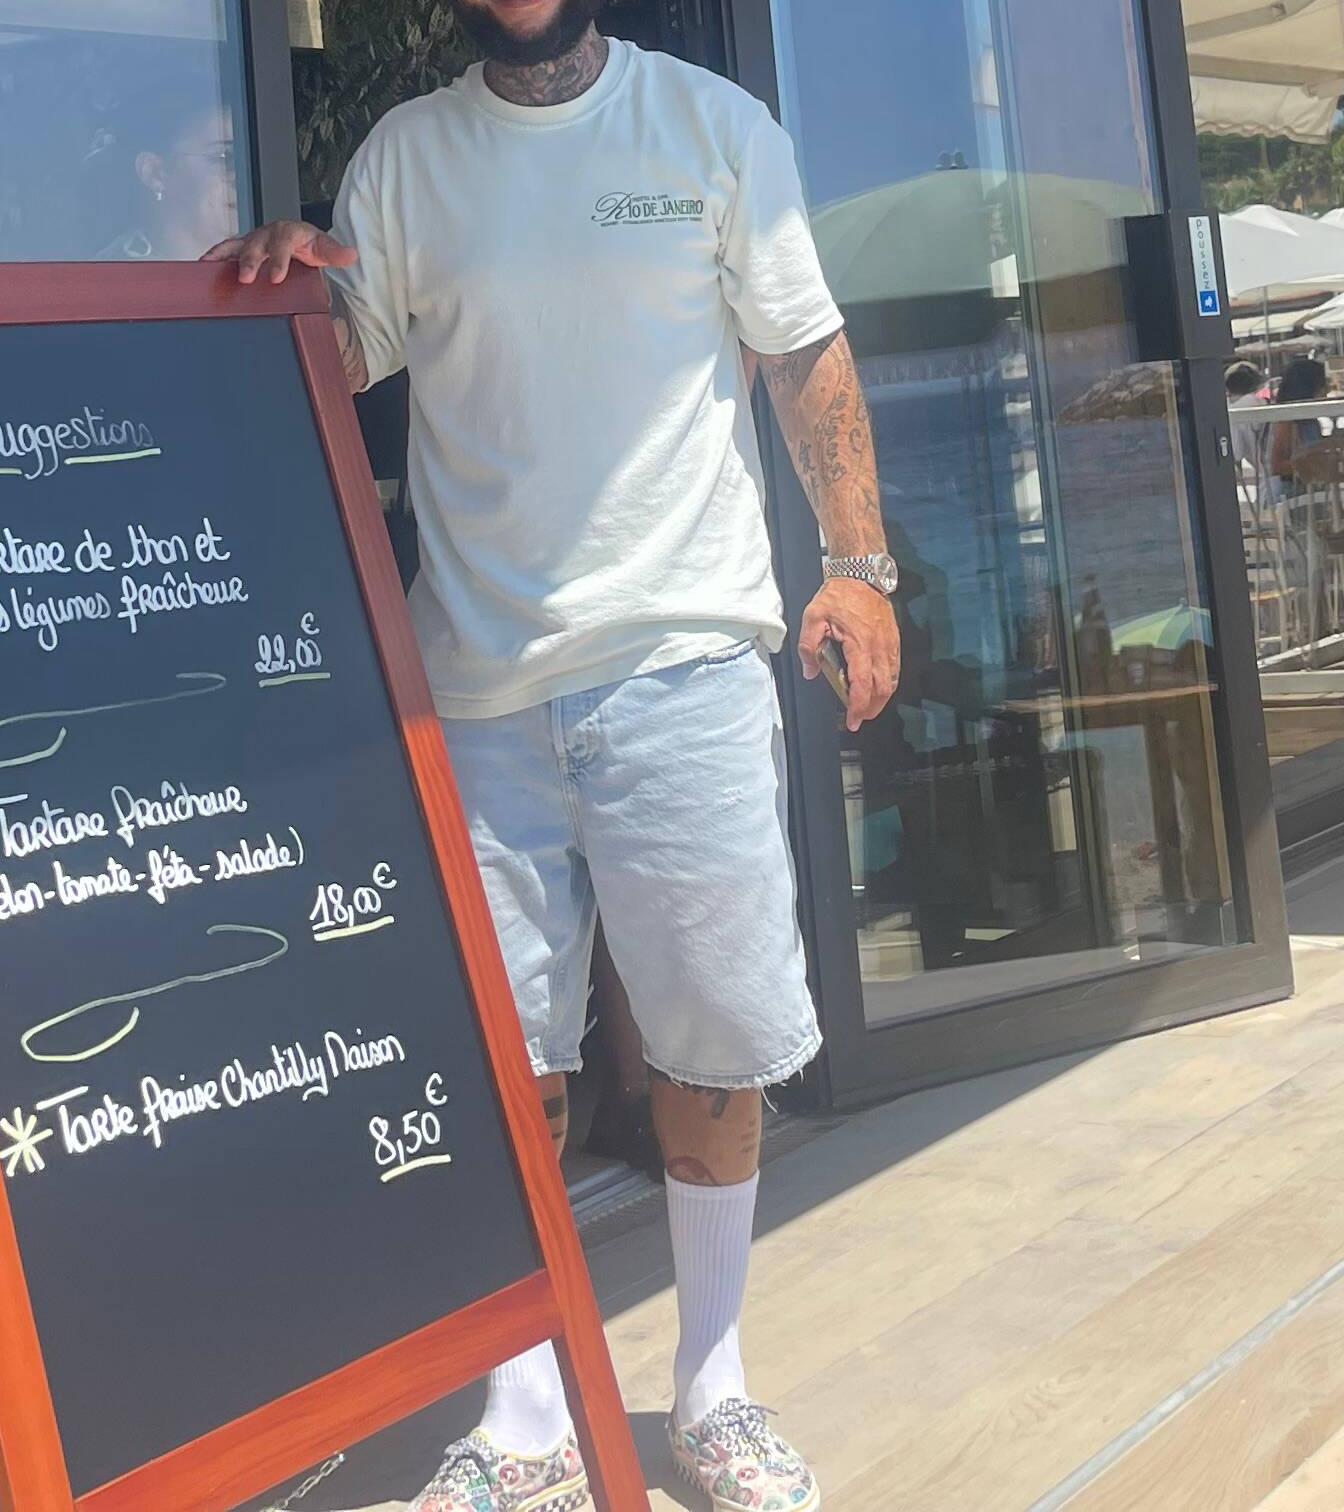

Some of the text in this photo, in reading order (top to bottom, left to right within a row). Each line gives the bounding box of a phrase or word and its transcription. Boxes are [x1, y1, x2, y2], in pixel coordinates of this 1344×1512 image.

[591, 191, 704, 222] RIO DE JANEIRO
[1196, 218, 1210, 290] poussez
[74, 528, 116, 572] de
[122, 524, 190, 569] thon
[194, 517, 231, 562] et
[10, 586, 113, 652] légumes
[117, 571, 250, 634] fraîcheur
[110, 780, 249, 849] fraîcheur
[35, 1028, 407, 1155] Tarte fraise Chantilly Maison
